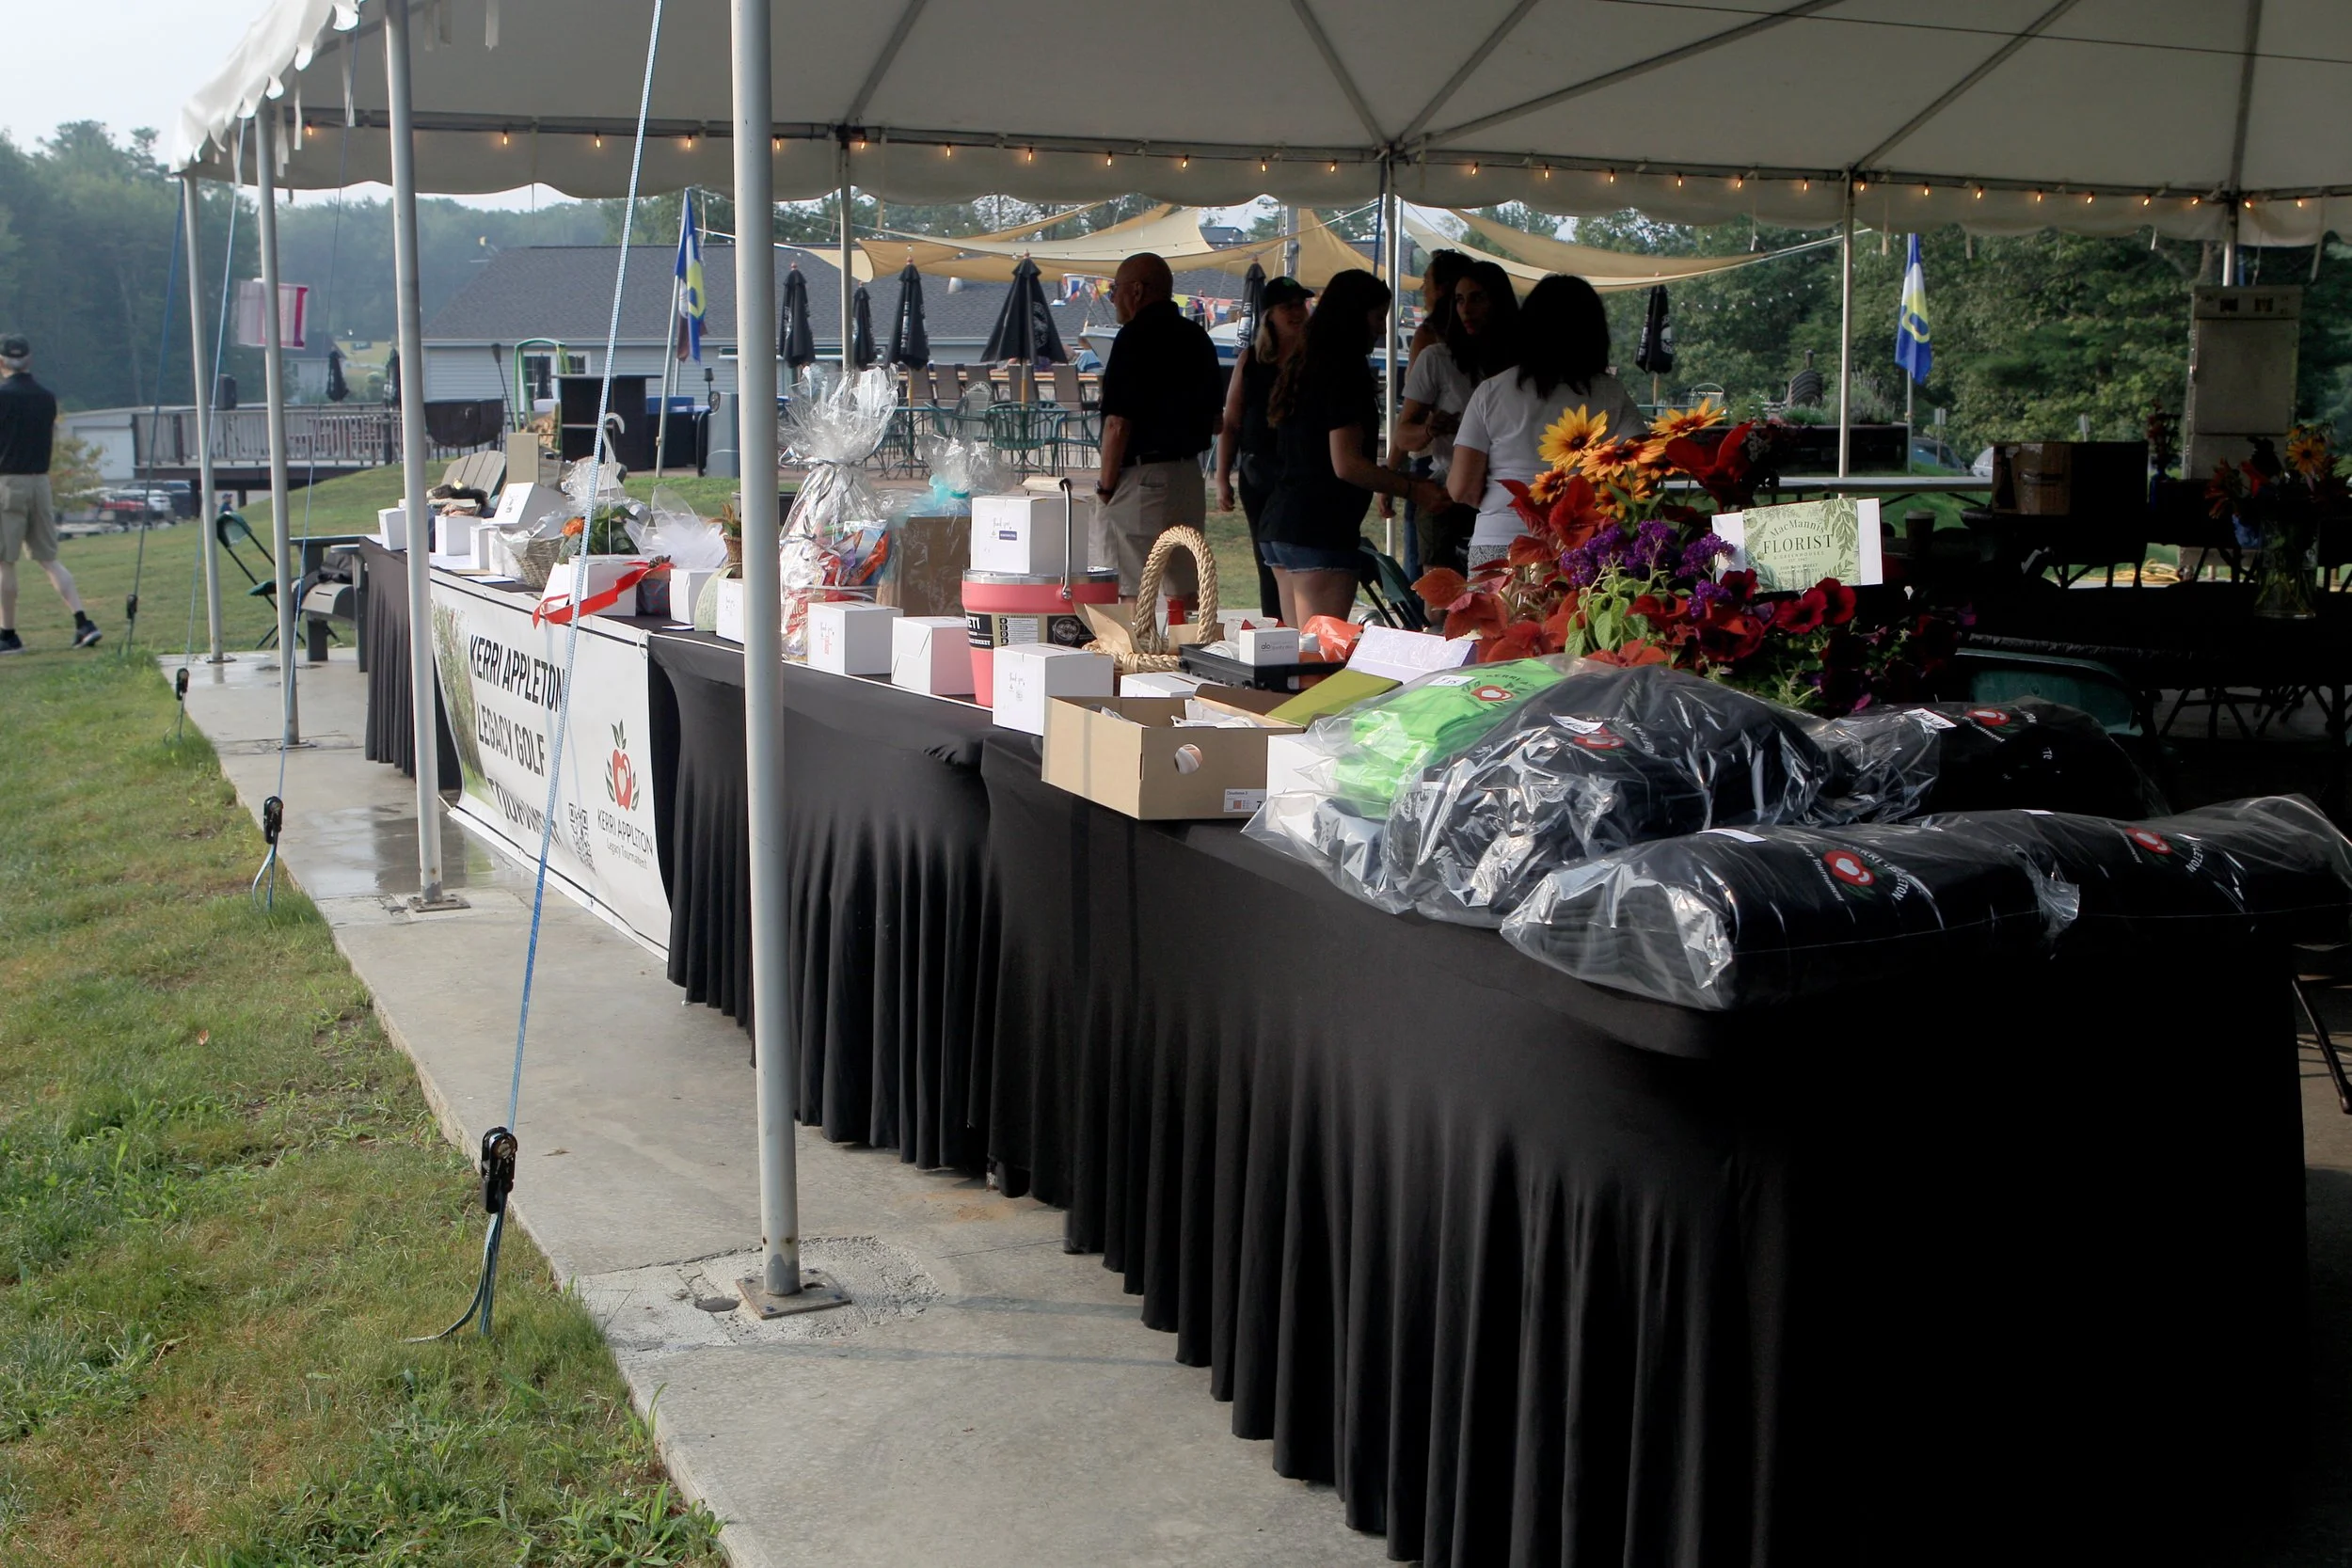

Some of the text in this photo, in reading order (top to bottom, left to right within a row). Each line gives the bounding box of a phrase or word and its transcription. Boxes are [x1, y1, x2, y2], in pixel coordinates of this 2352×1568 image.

[1763, 533, 1834, 555] FLORIST
[1770, 518, 1825, 537] MacMannis
[967, 616, 981, 629] ETI
[470, 634, 565, 713] KERRI APPLETON
[476, 701, 545, 778] LEGACY GOLF
[597, 808, 654, 857] KERRI APPLETON
